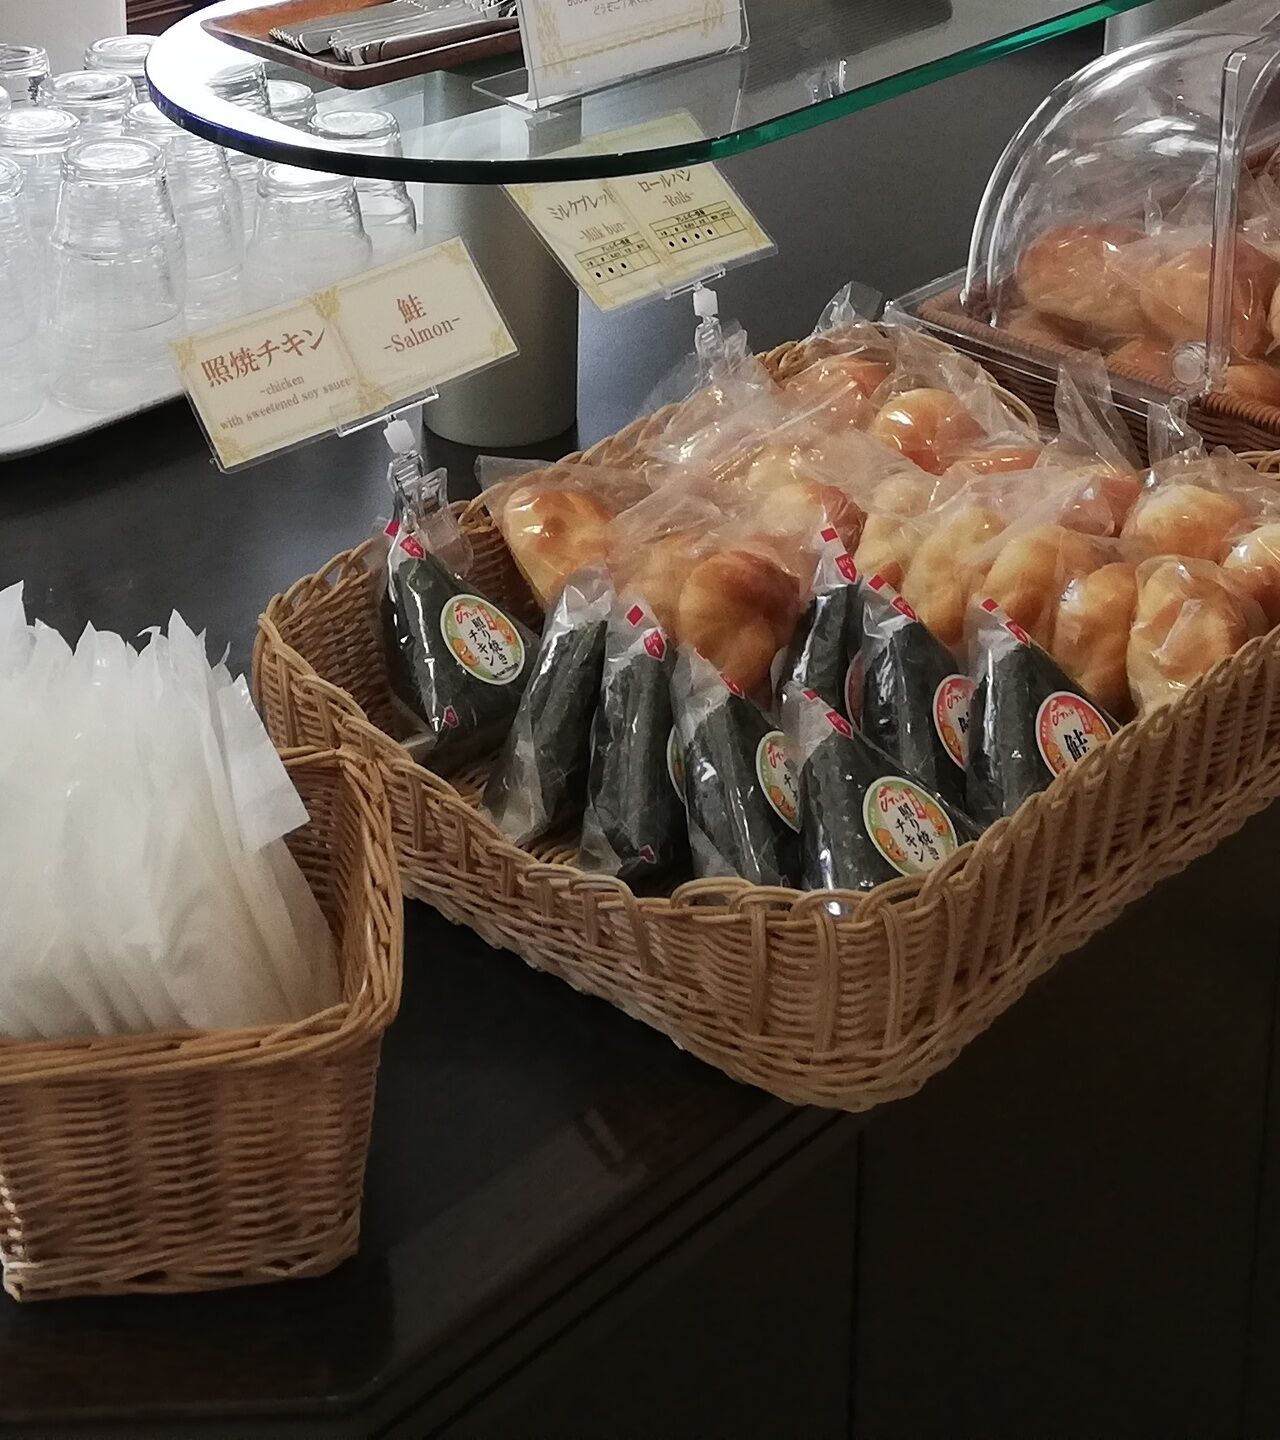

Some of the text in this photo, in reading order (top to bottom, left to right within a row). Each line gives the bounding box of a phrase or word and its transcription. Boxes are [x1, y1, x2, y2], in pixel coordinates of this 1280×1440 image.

[637, 168, 692, 194] ロールパン
[396, 293, 427, 325] 鮭
[200, 327, 326, 388] 照焼チキン
[220, 414, 244, 432] with
[245, 393, 300, 423] sweetened
[301, 388, 320, 403] soy
